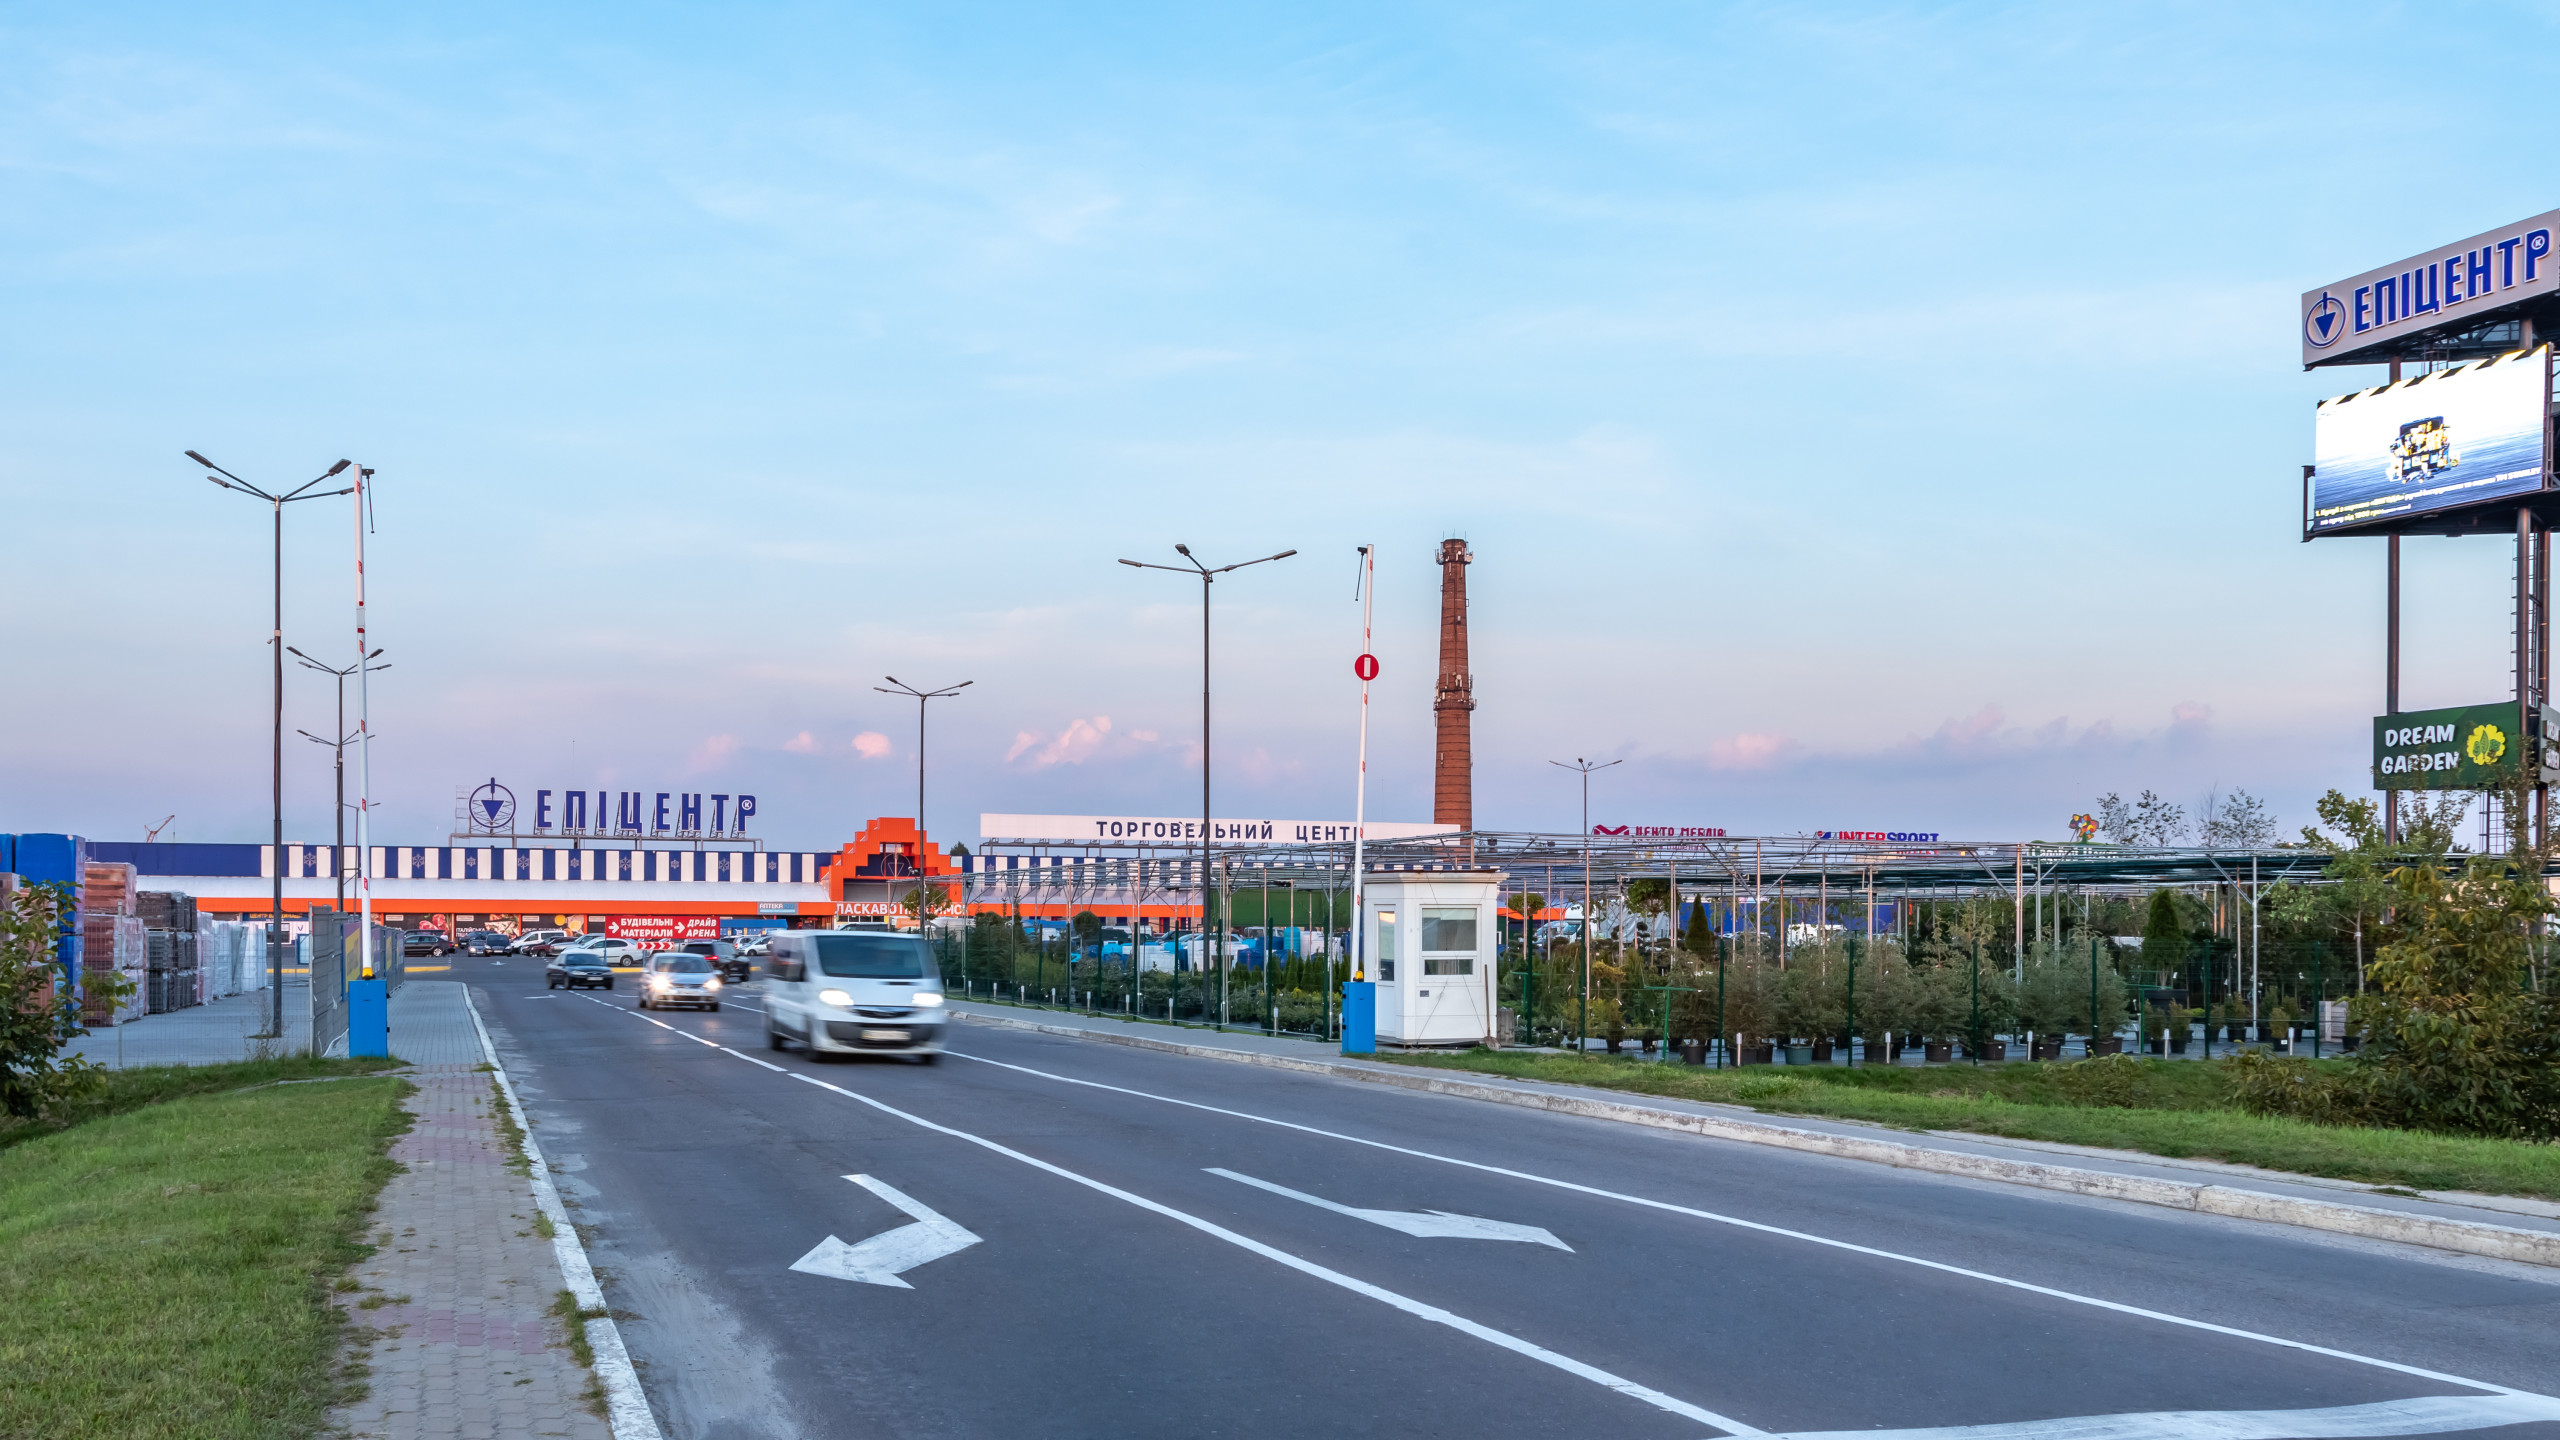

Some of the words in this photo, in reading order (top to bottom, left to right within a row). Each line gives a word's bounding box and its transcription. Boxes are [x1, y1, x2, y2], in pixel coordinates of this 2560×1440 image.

[2353, 228, 2551, 335] ЕПІЦЕНТР
[2385, 724, 2455, 747] DREAM
[2381, 752, 2459, 775] GARDEN
[536, 789, 757, 834] ЕПІЦЕНТР
[1839, 831, 1940, 844] INTERSPORT
[835, 903, 896, 915] ЛАСКАВО
[621, 918, 673, 927] БУДІВЕЛЬНІ
[687, 918, 717, 928] ДРАЙВ
[620, 929, 673, 937] МАТЕРІАЛИ
[686, 929, 716, 937] АРЕНА
